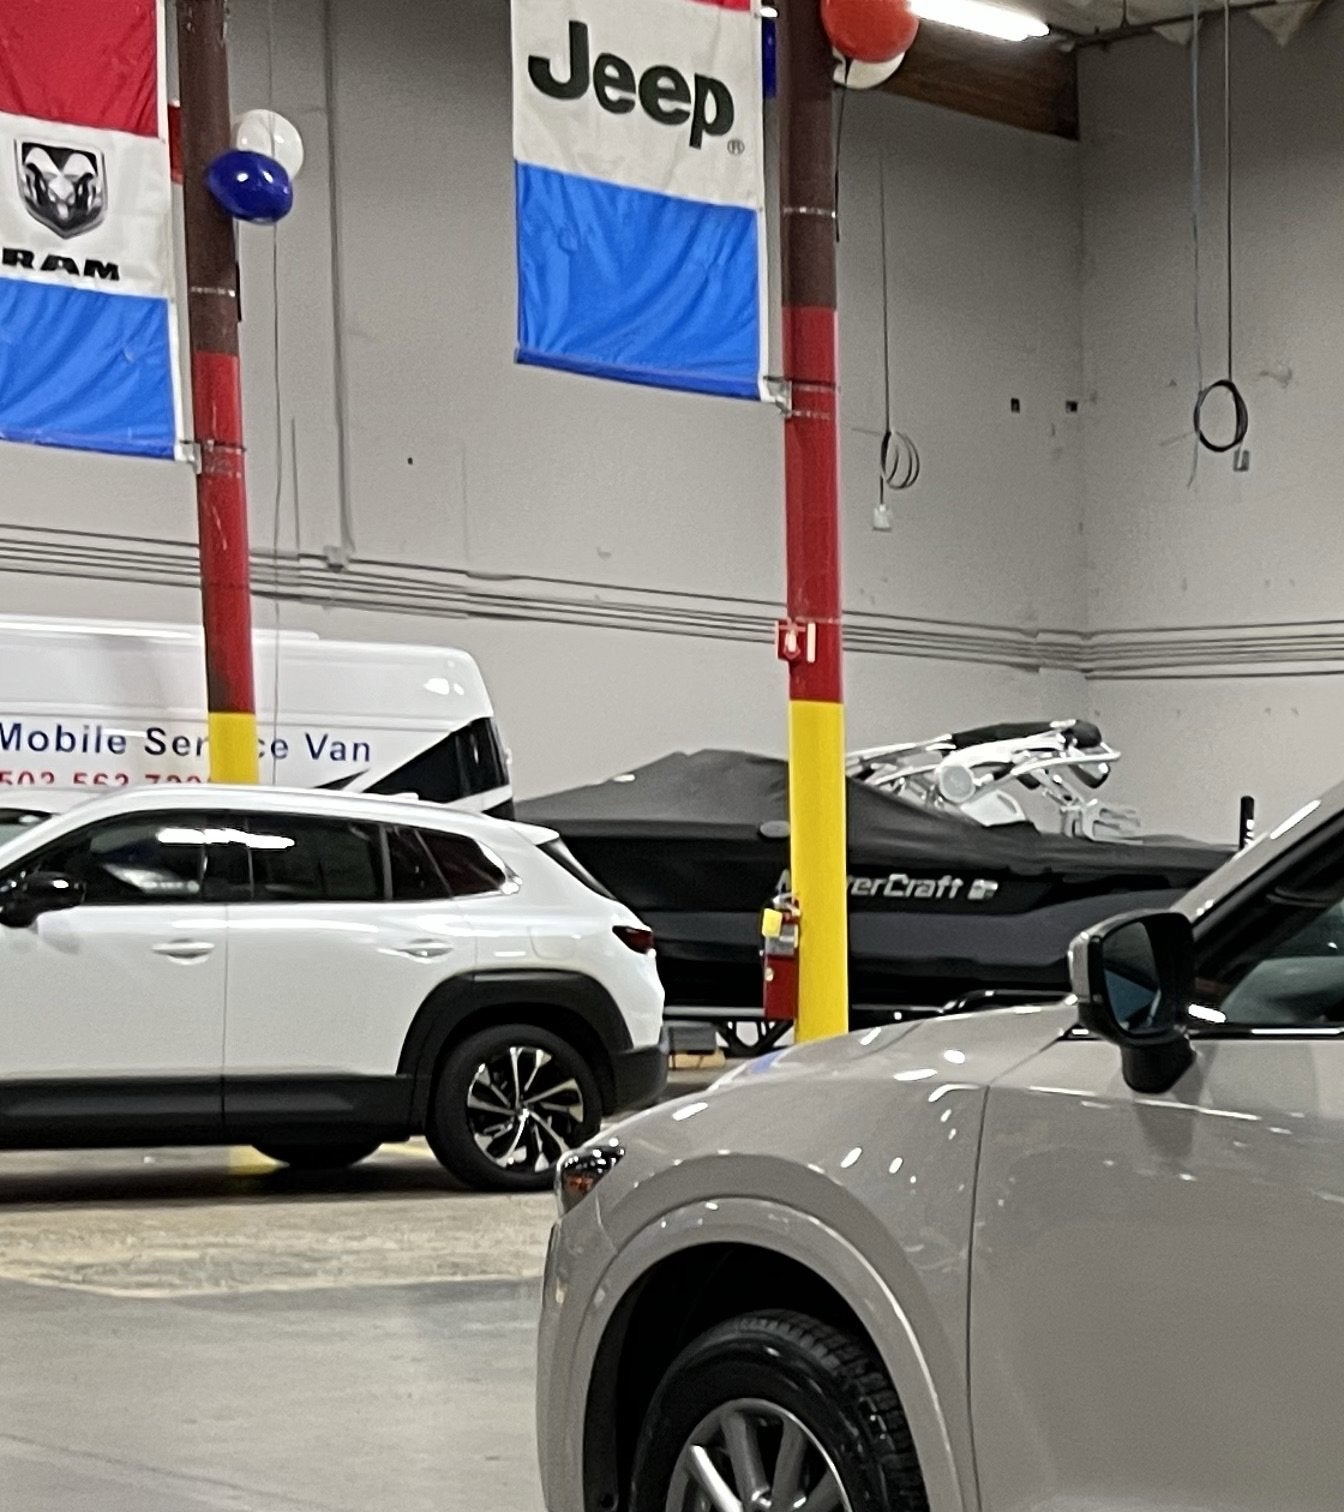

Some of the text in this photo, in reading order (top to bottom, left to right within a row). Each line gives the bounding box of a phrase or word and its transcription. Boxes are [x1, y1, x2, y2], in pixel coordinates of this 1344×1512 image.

[528, 20, 734, 150] Jeep
[2, 247, 119, 281] RAM
[0, 722, 370, 762] Mobile Sere Van
[776, 868, 963, 899] erCraft
